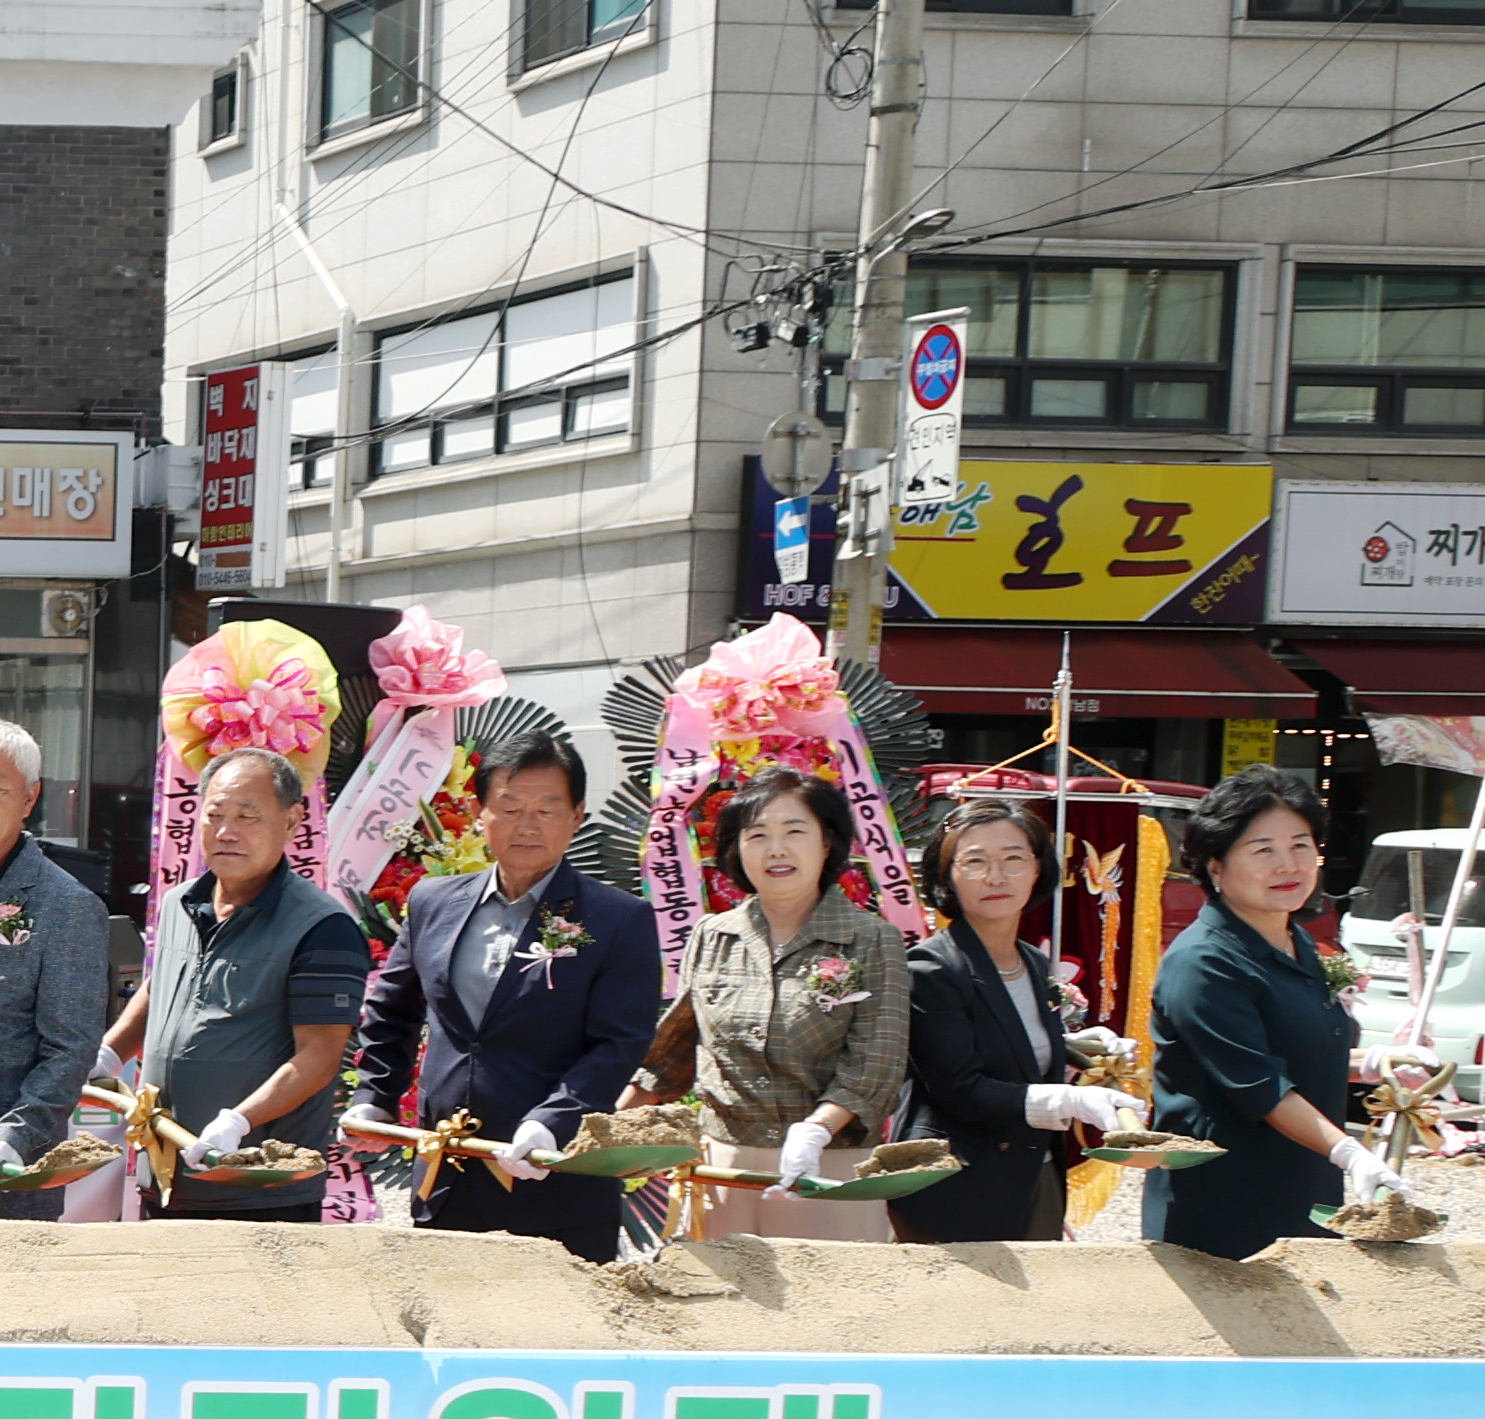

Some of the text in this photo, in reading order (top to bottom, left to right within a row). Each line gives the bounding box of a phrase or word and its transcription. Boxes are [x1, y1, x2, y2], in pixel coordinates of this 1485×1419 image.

[208, 383, 225, 417] 벽
[206, 425, 256, 465] 바닥재
[763, 583, 815, 607] HOF
